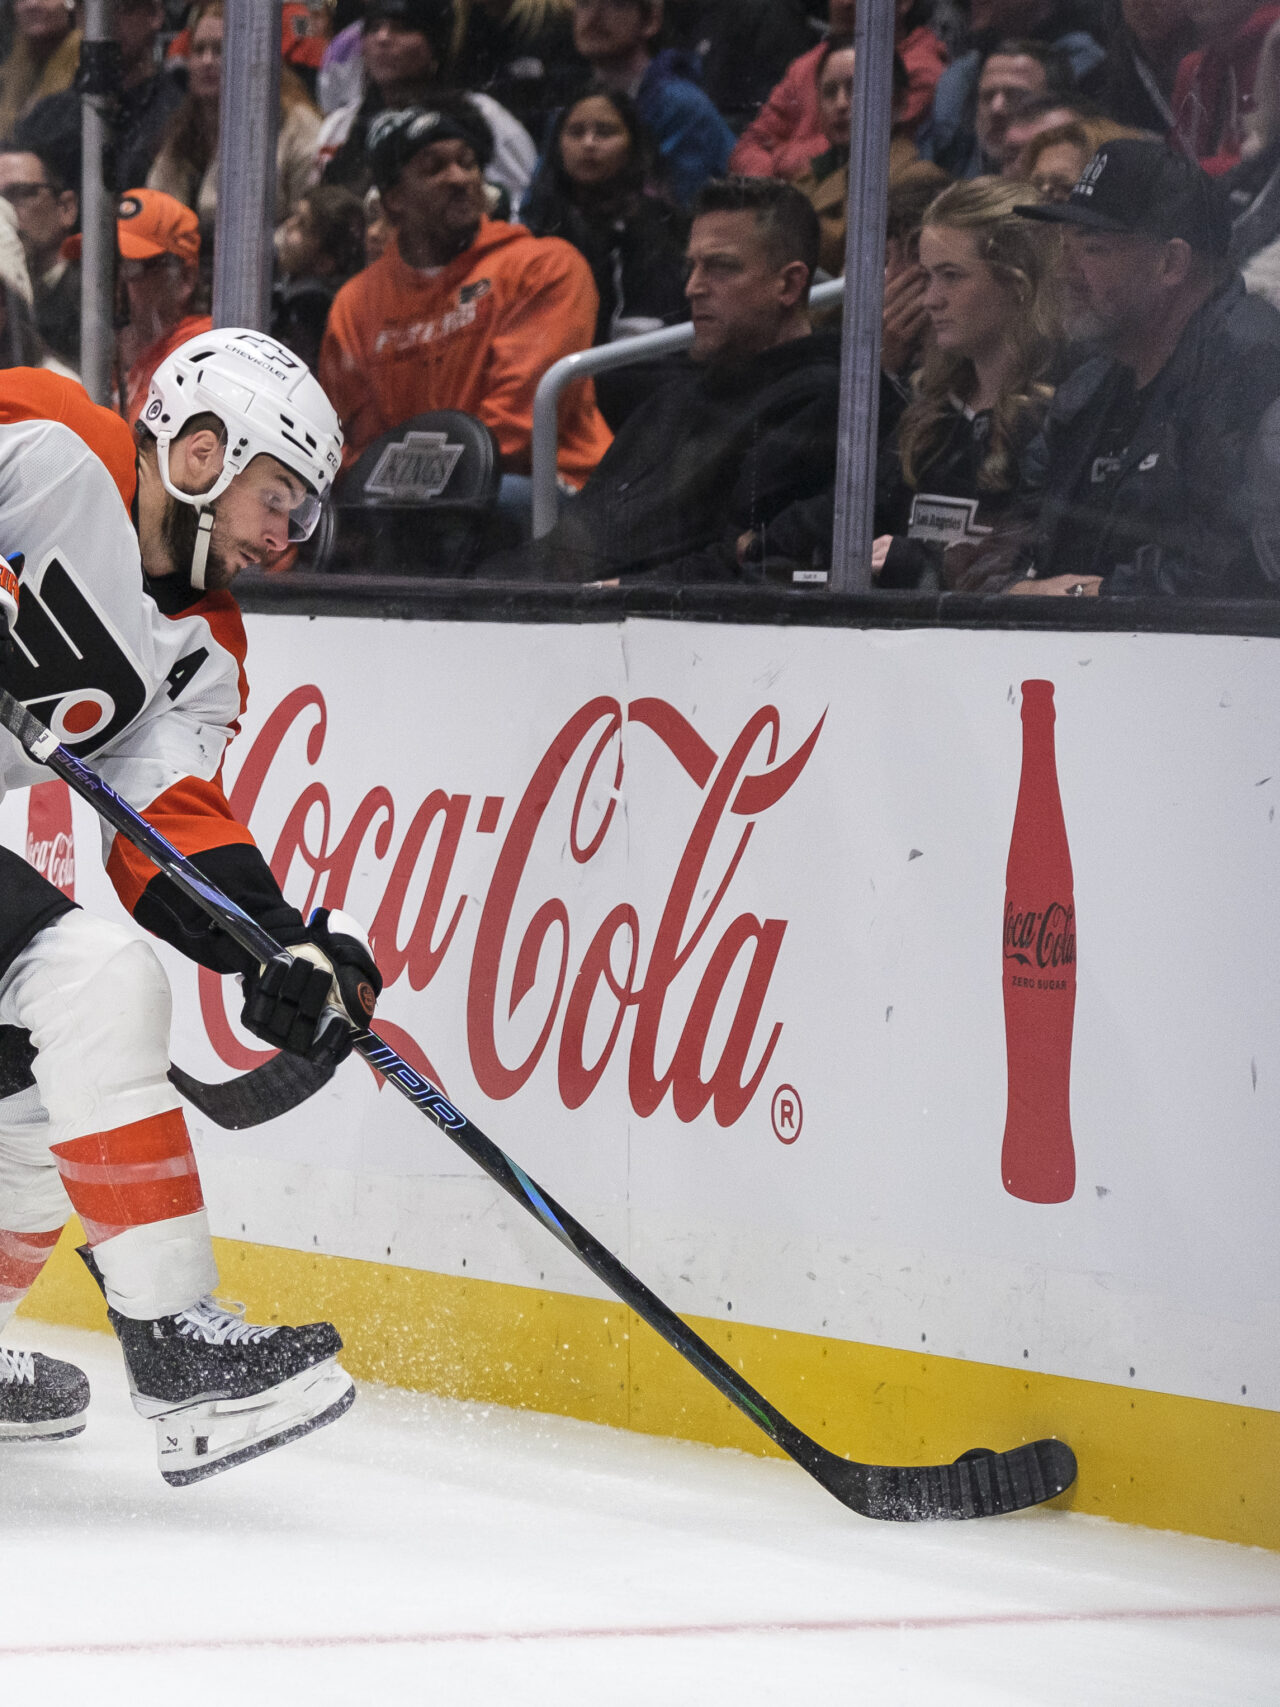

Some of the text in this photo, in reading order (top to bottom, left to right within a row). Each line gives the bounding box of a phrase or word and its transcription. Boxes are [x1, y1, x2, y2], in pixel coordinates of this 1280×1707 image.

[225, 344, 288, 381] CHEVROLET
[326, 451, 339, 471] CC
[166, 646, 210, 702] A
[52, 748, 99, 791] AUER
[197, 684, 830, 1128] Coca-Cola
[1003, 900, 1076, 969] Coca-Cola
[1011, 975, 1067, 991] ZERO SUGAR
